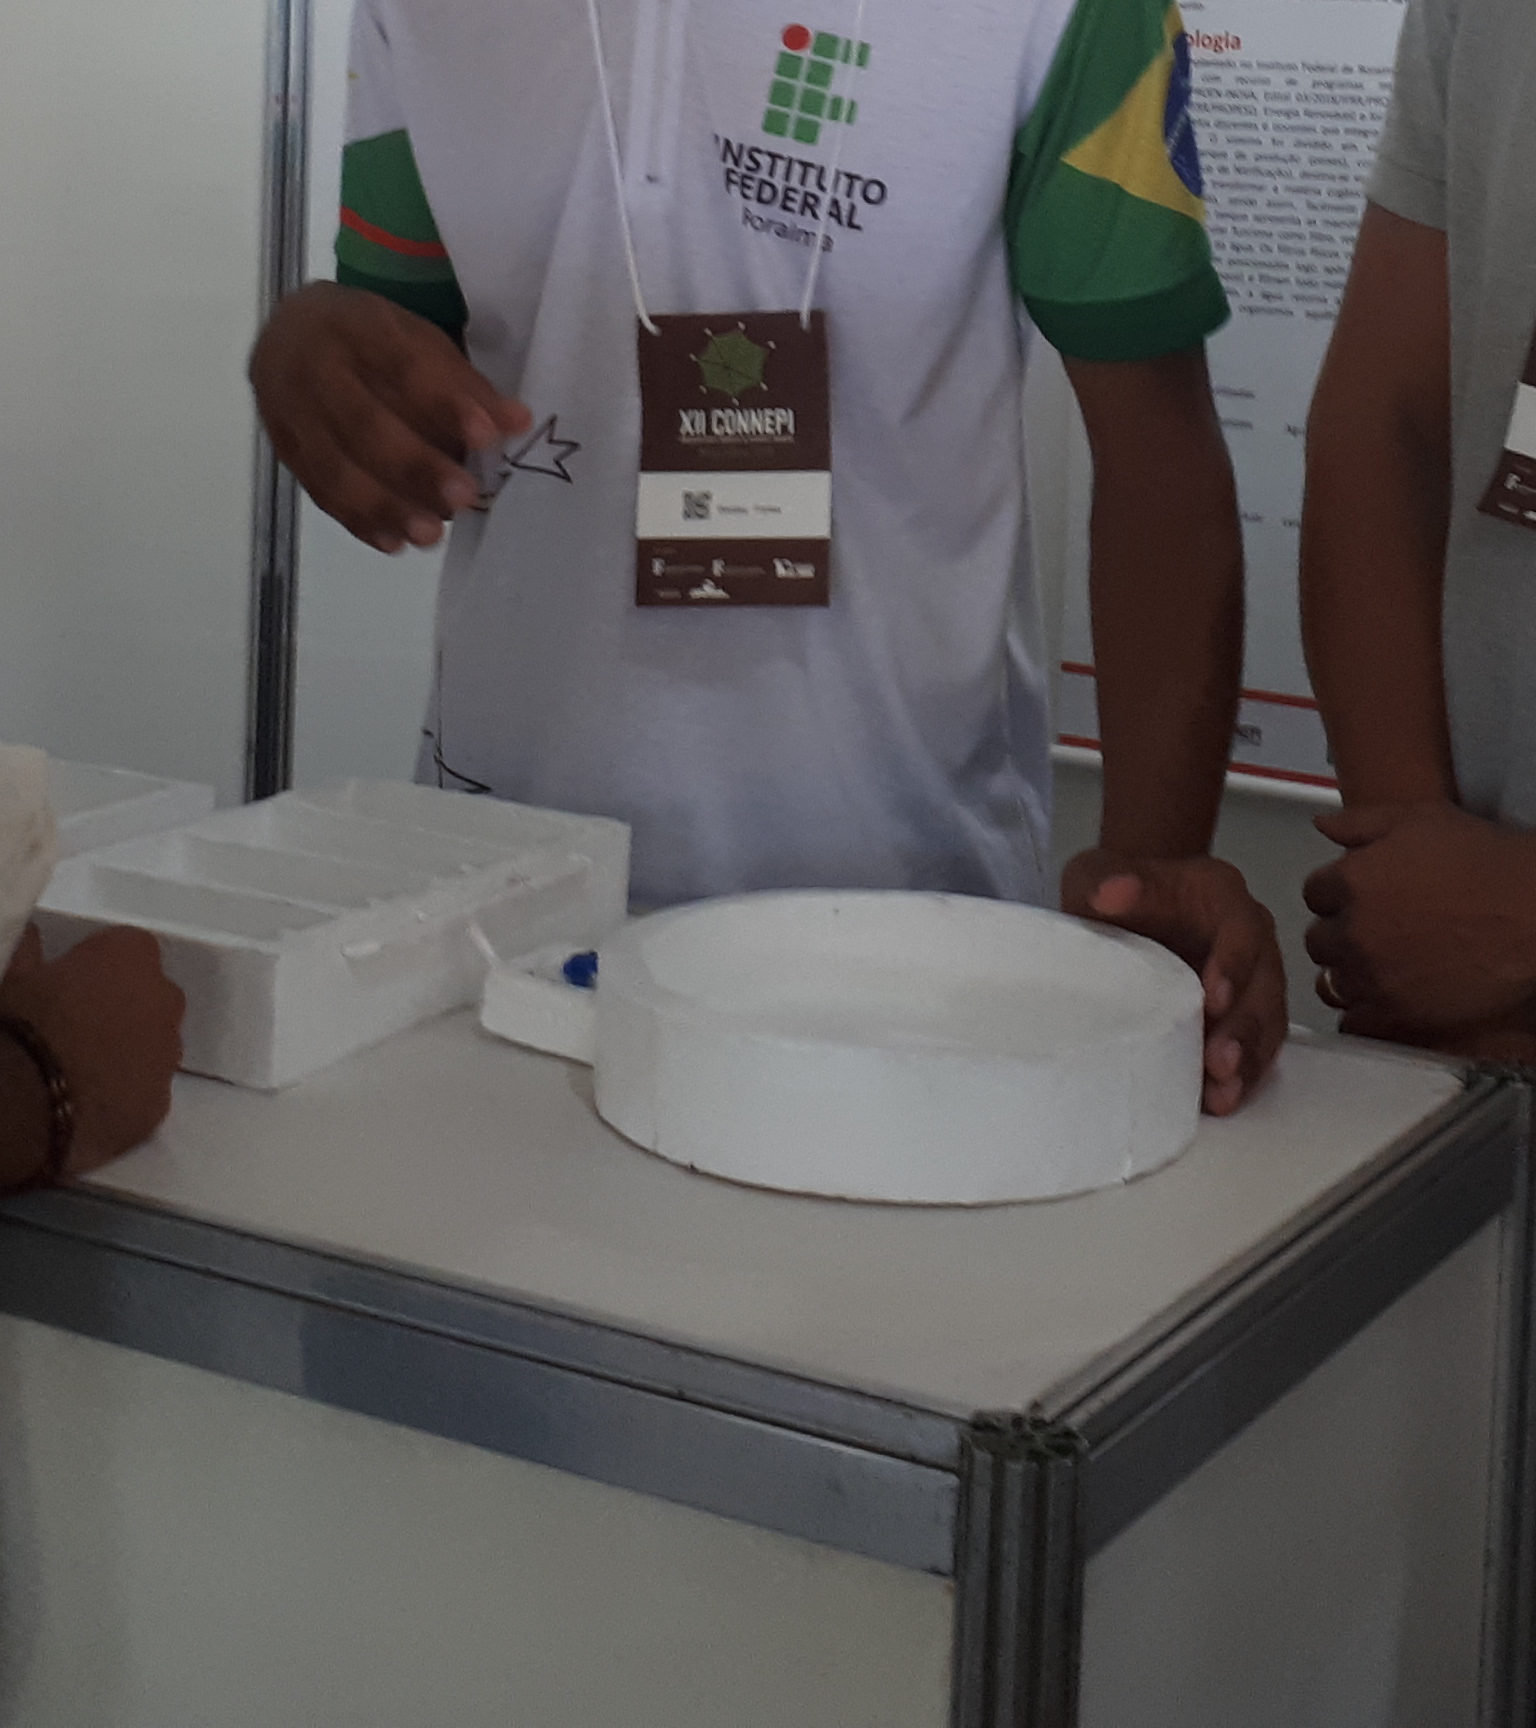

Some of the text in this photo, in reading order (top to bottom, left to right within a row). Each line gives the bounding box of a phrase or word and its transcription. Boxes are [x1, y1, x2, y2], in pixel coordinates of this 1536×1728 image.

[725, 167, 864, 232] FEDERAL
[678, 408, 795, 436] XII CONNEPI
